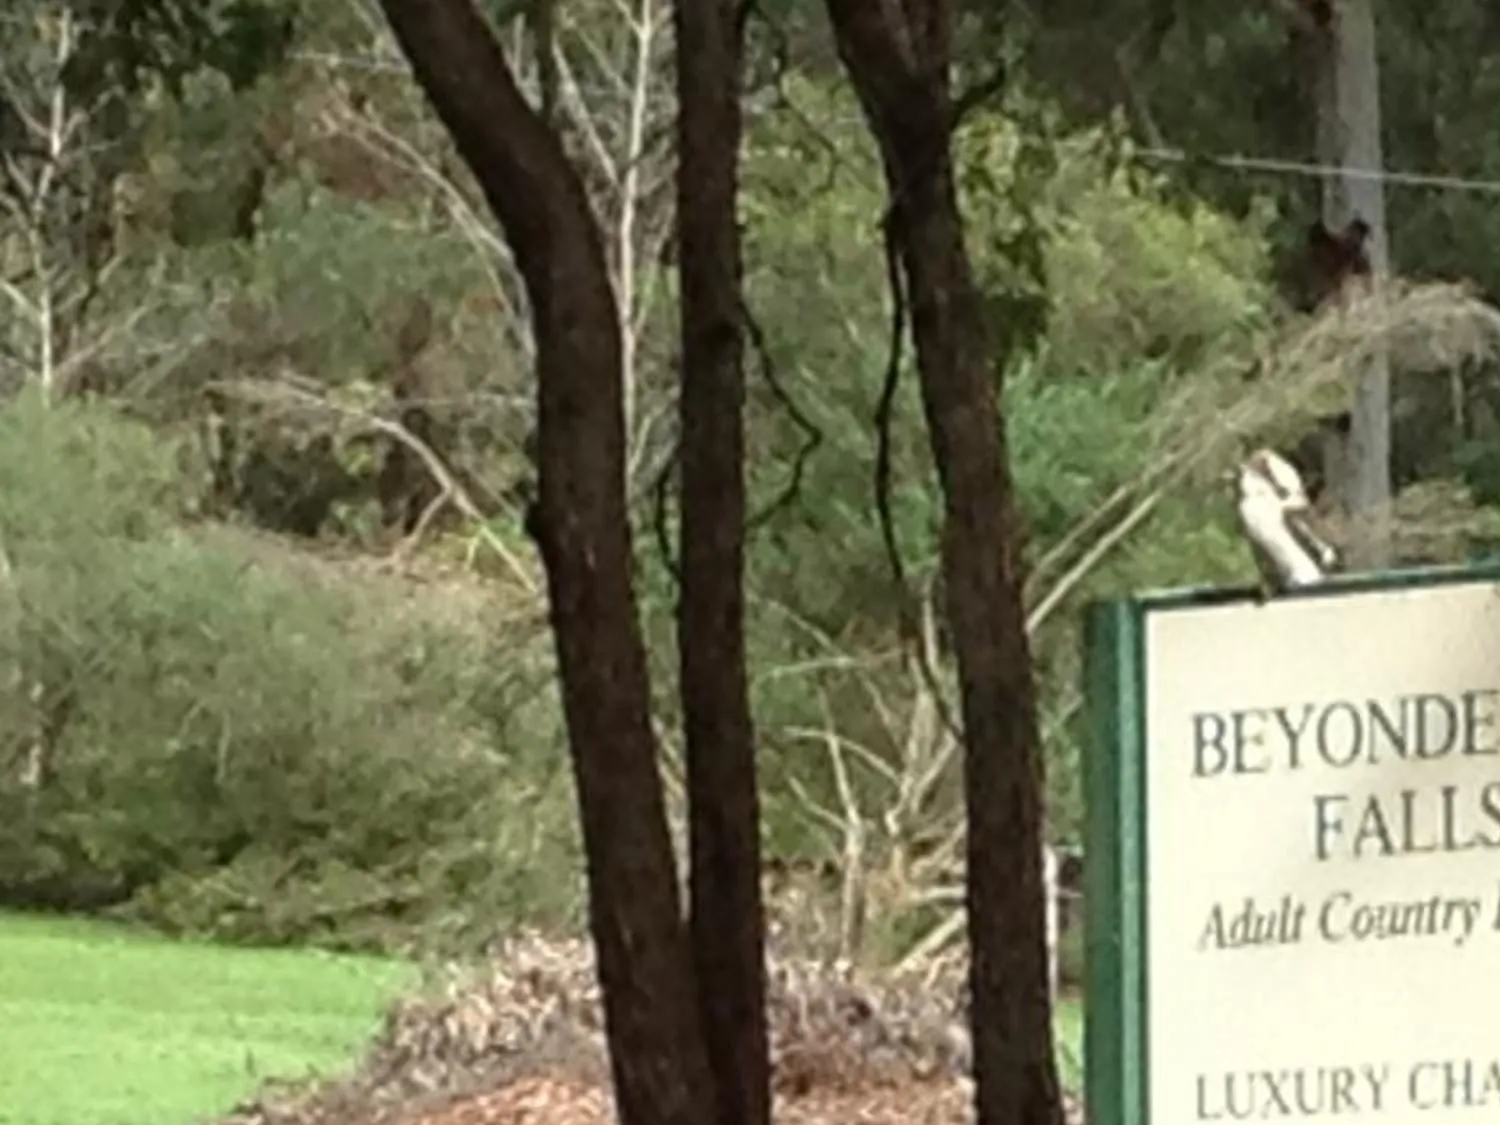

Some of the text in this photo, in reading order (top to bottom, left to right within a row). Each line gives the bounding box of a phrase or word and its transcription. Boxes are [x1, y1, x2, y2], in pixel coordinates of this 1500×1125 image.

[1197, 894, 1306, 951] Adult
[1318, 891, 1481, 946] Country
[1195, 1061, 1390, 1121] LUXURY
